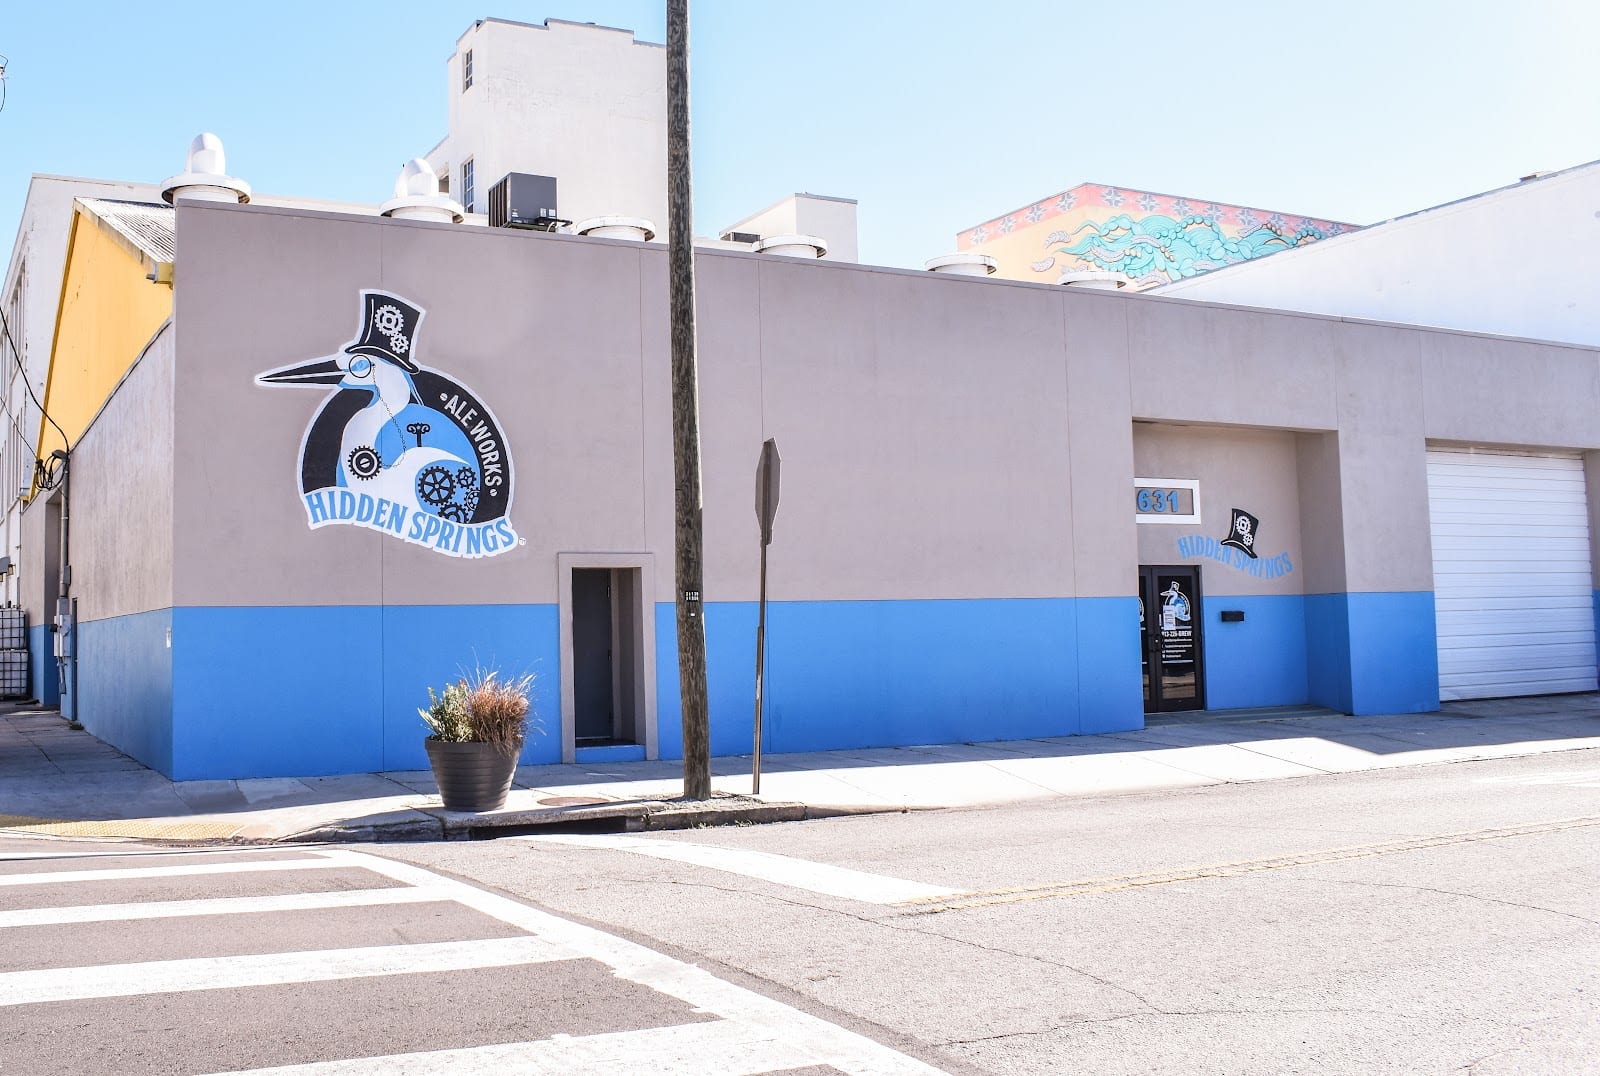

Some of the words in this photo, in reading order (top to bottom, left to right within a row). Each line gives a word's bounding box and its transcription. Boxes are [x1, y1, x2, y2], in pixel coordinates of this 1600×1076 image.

[444, 394, 478, 427] ALE
[470, 419, 503, 487] WORKS
[304, 490, 408, 535] HIDDEN
[408, 511, 515, 555] SPRINGS
[1137, 489, 1179, 512] 631
[1177, 535, 1233, 565] HIDDEN
[1233, 550, 1293, 579] SPRINGS
